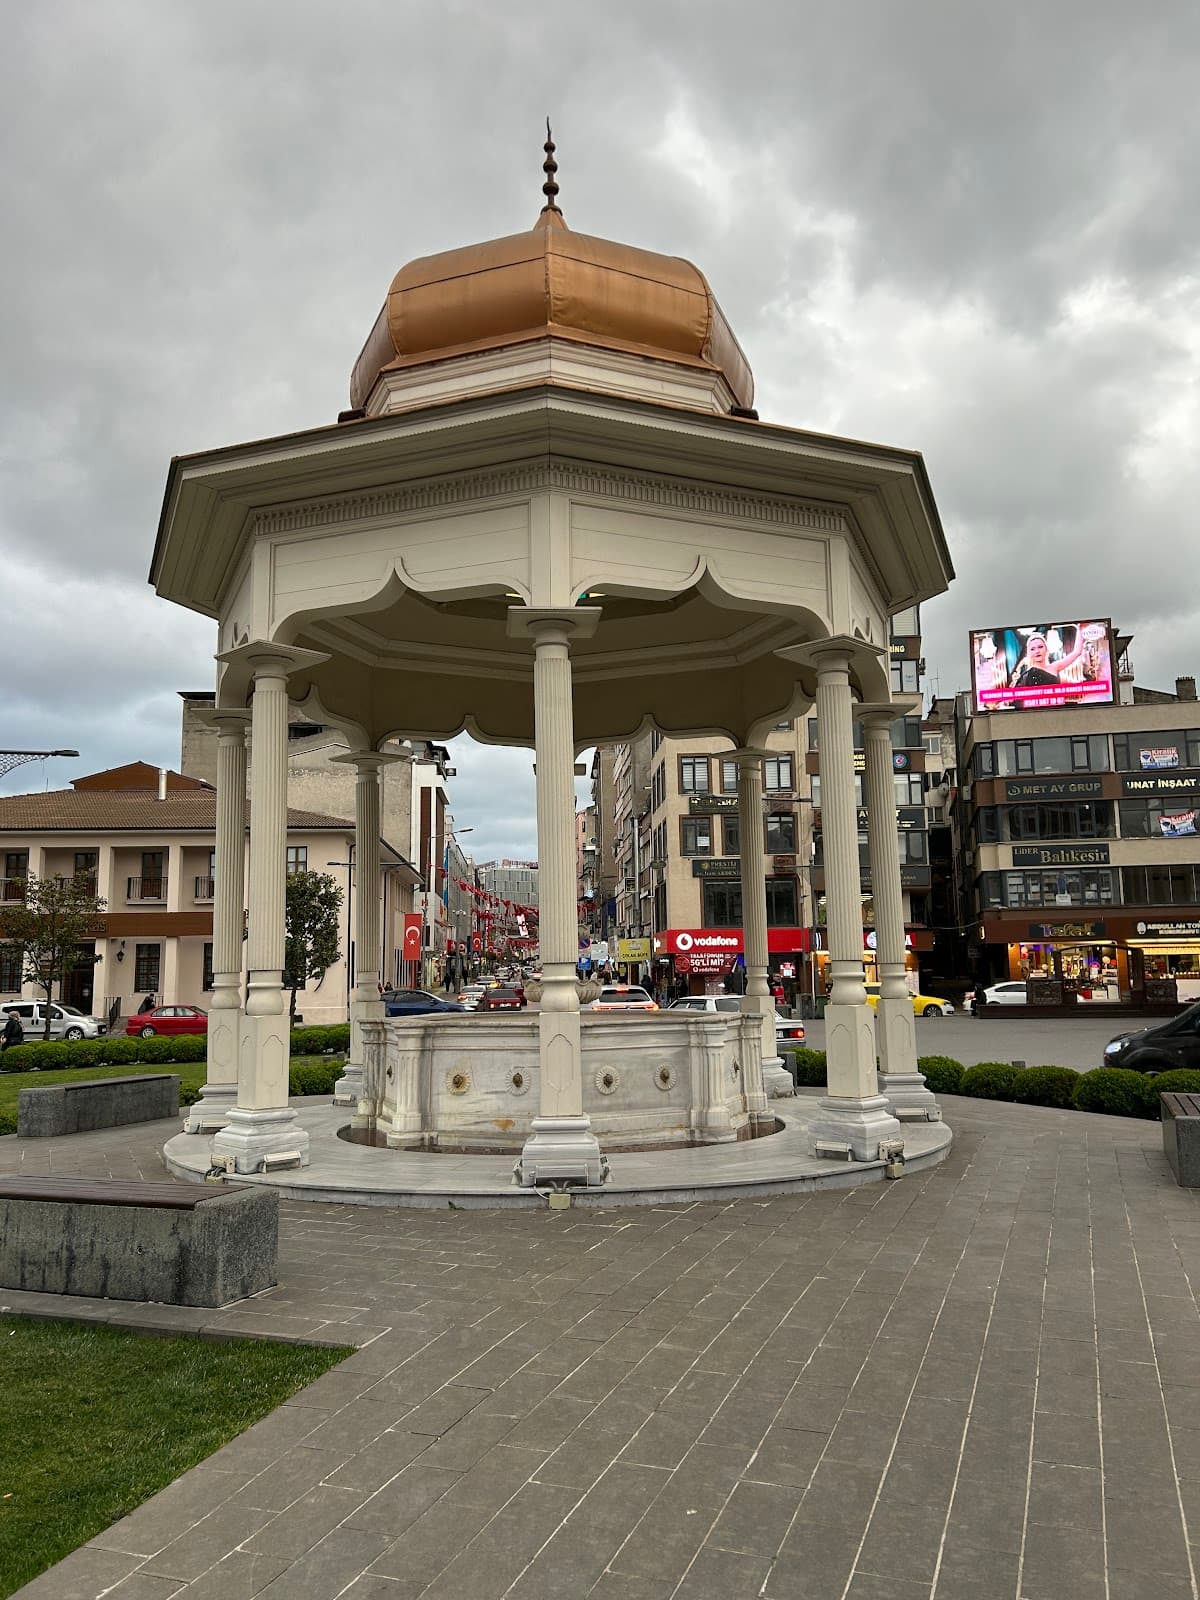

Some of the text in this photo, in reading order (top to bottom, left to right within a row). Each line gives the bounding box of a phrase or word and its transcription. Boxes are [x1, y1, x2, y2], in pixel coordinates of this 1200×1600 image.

[1022, 783, 1101, 794] MET AY GRUP
[1158, 778, 1197, 789] İNŞAAT
[1040, 848, 1108, 863] Balıkesir
[693, 936, 739, 946] vodafone
